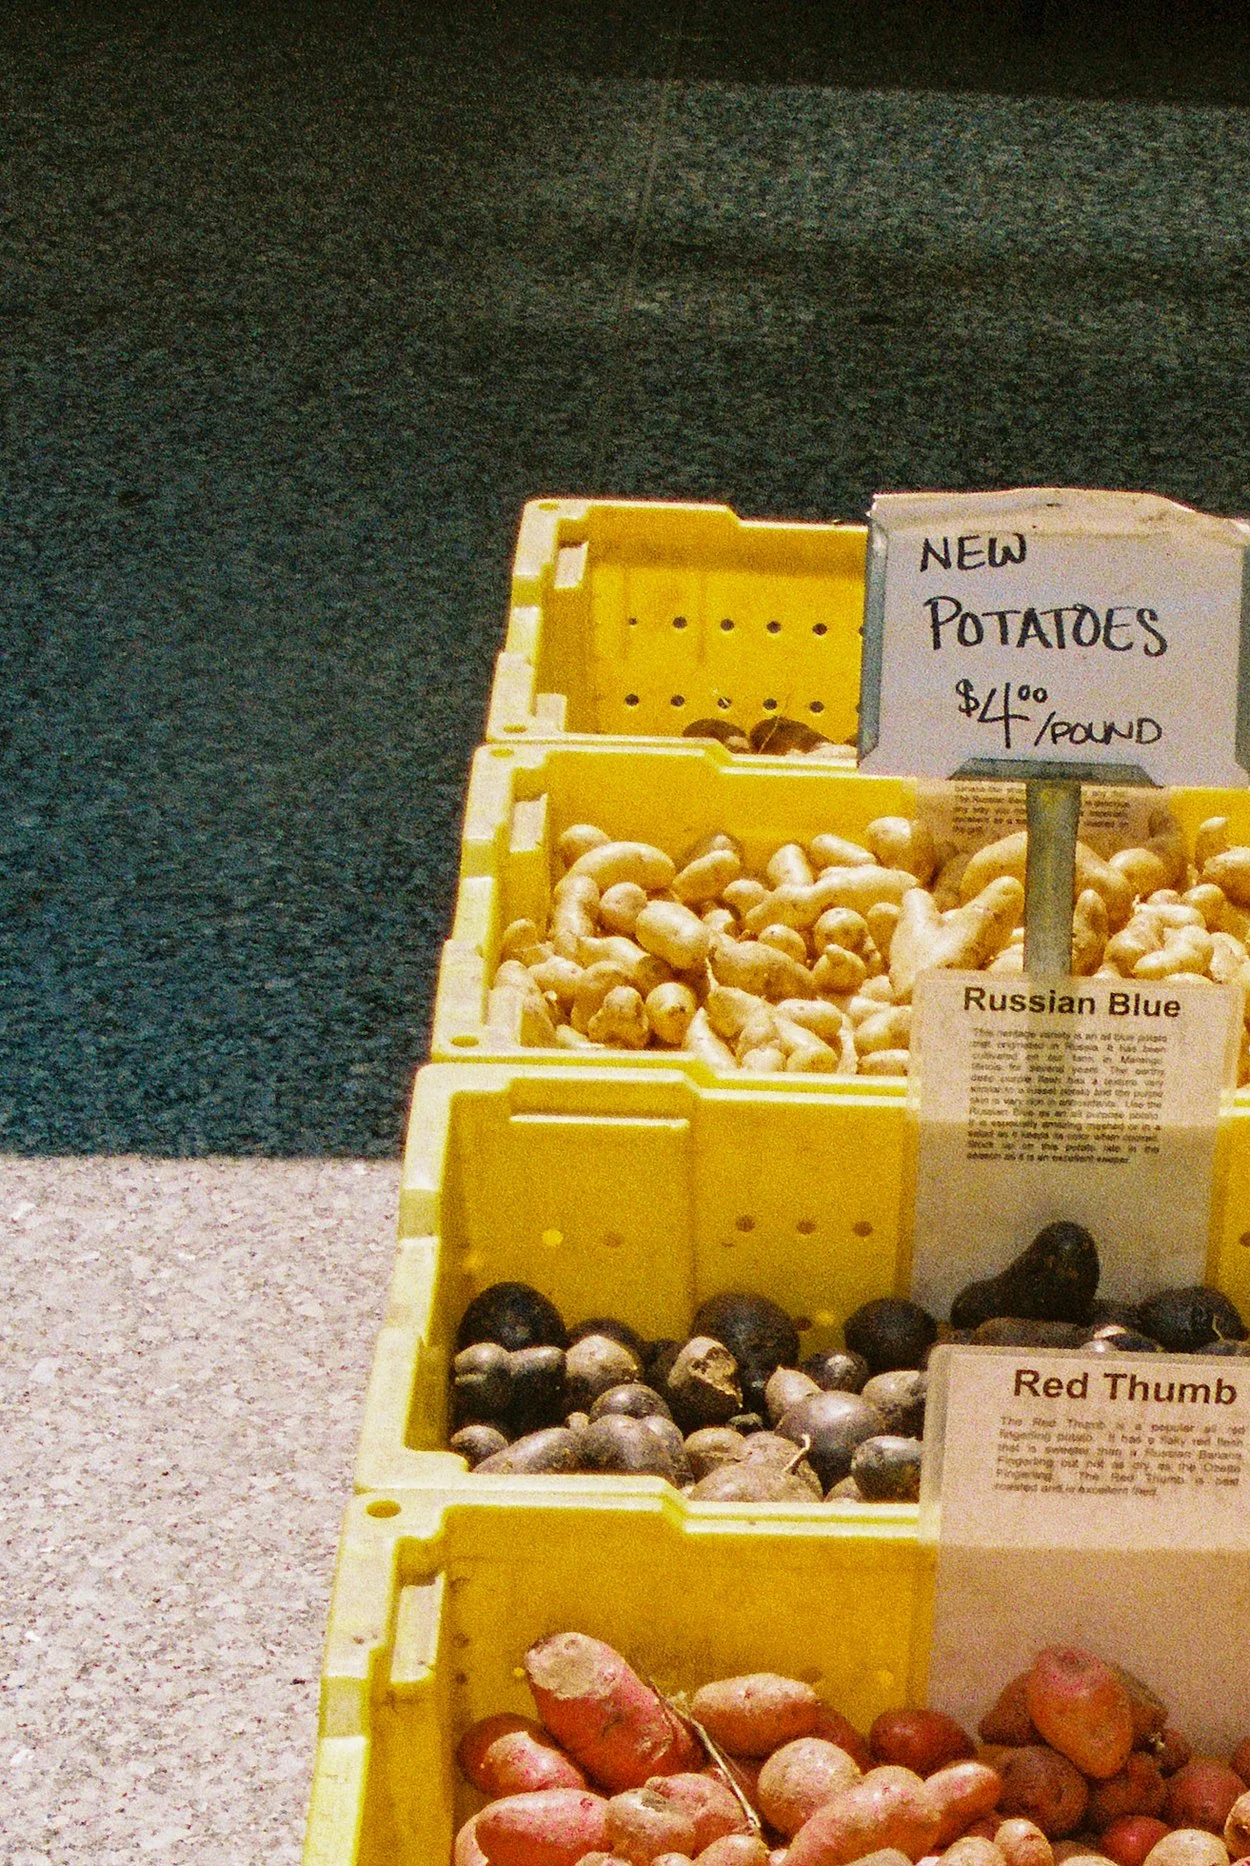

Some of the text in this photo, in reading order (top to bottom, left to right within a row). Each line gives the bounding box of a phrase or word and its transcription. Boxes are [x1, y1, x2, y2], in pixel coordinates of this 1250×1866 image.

[919, 532, 1027, 572] NEW
[924, 596, 1168, 657] POTATOES
[963, 986, 1181, 1018] Russian Blue
[1013, 1369, 1238, 1405] Red Thumb
